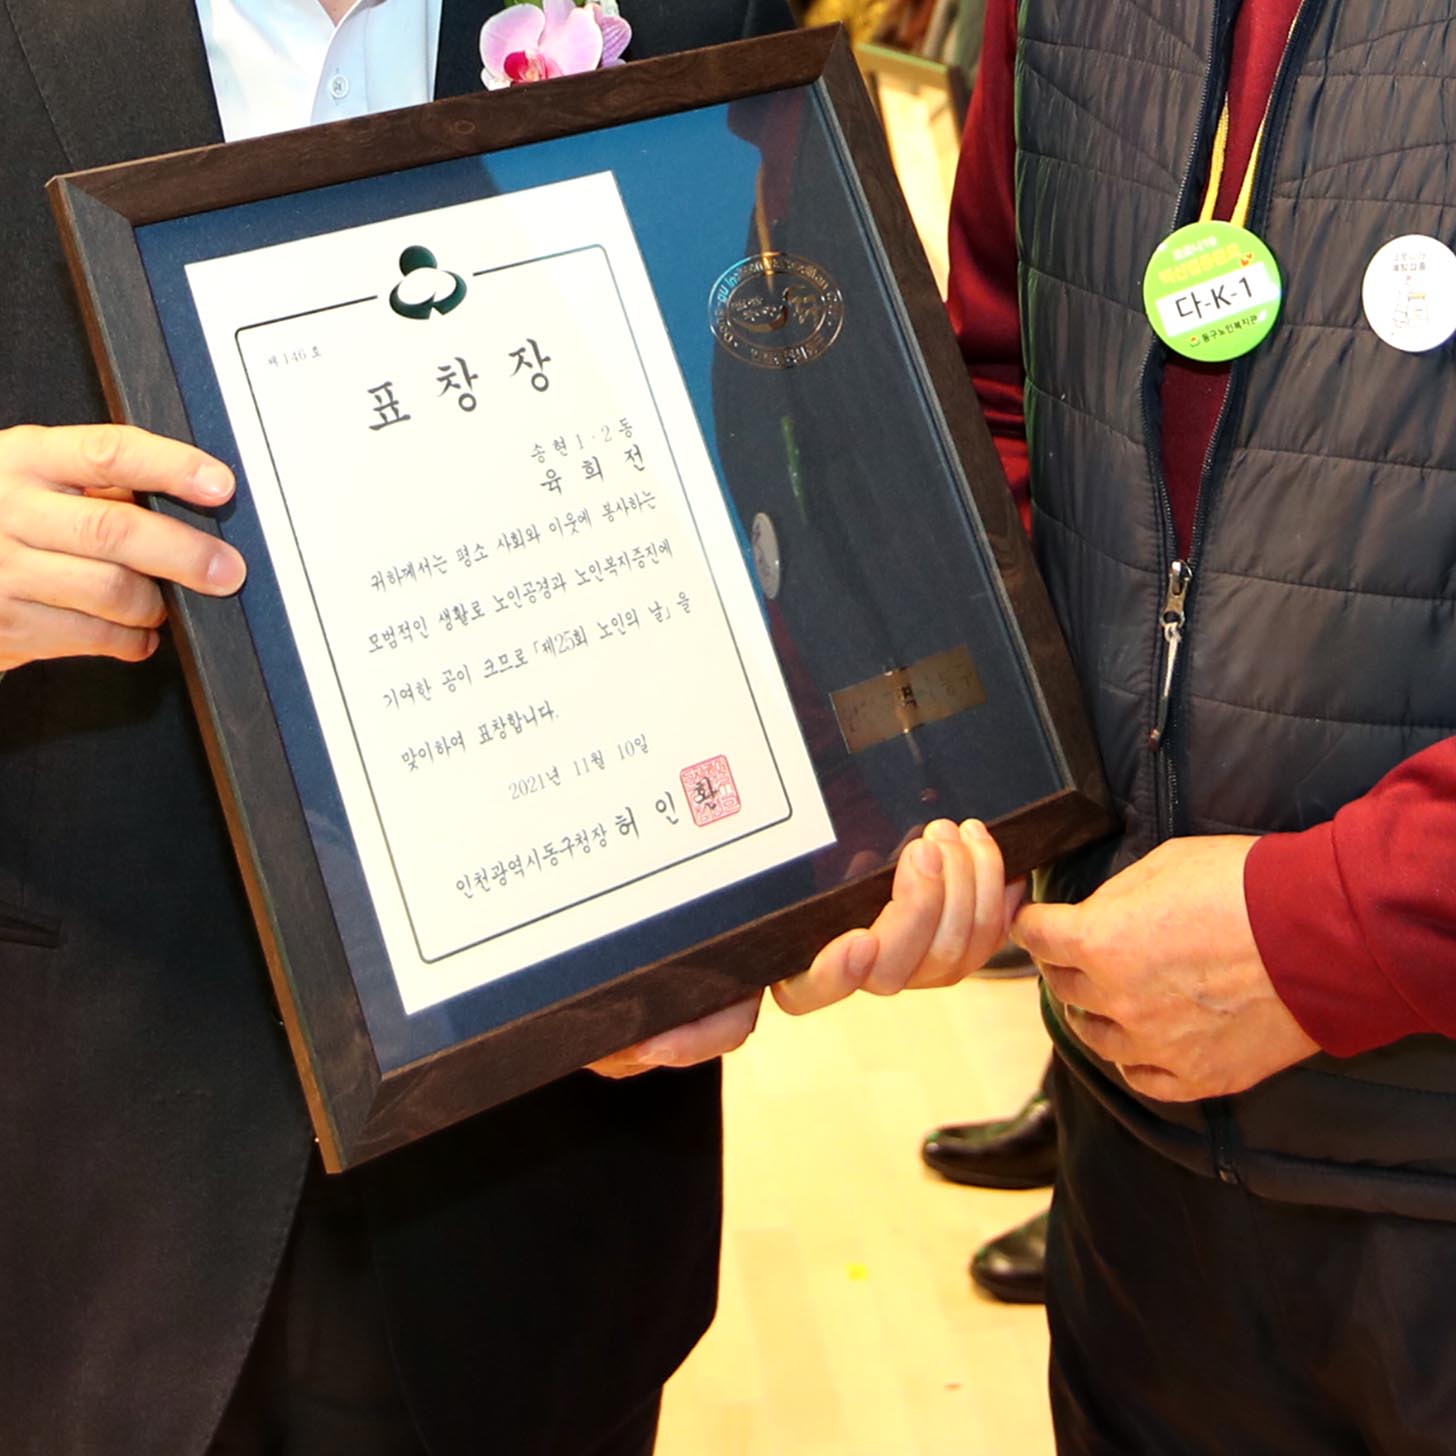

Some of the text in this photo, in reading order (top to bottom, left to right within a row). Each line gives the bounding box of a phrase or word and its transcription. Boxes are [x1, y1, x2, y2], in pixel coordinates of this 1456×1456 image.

[1175, 277, 1252, 319] 다-K-1
[1201, 315, 1257, 343] 동구노인복지관
[371, 490, 656, 593] 귀하께서는 평소 사회와 이웃에 봉사하는
[368, 538, 673, 654] 모범적인 생활로 노인공경과 노인복지증진에
[383, 677, 432, 710] 기여한
[442, 664, 473, 693] 공이
[483, 648, 529, 679] 크므로
[596, 608, 640, 640] 노인의
[401, 730, 466, 773] 맞이하여
[508, 733, 649, 800] 2021년 11월 10일
